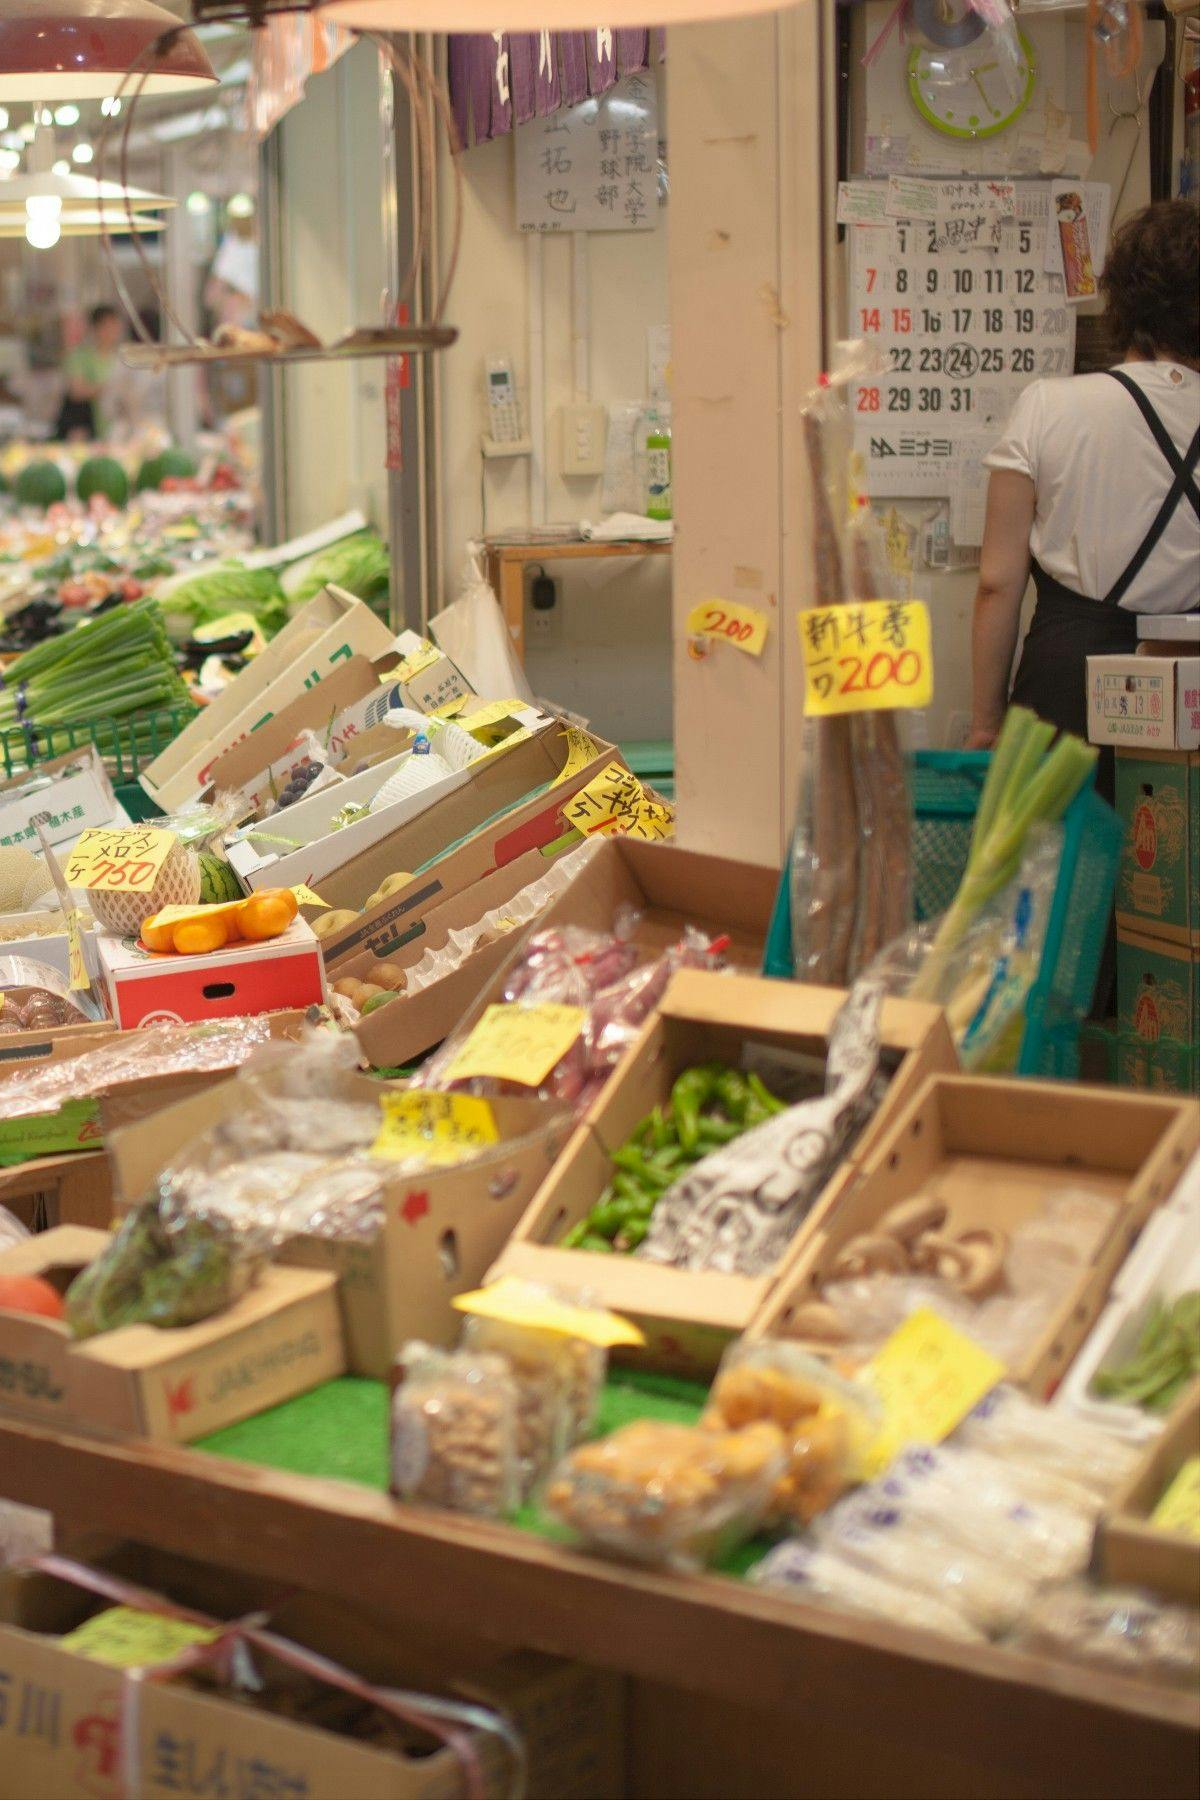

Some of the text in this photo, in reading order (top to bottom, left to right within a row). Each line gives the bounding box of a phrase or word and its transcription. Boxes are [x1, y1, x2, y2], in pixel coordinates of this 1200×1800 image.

[1019, 229, 1032, 253] 5
[866, 268, 878, 294] 7
[896, 269, 908, 293] 8
[926, 269, 938, 293] 9
[954, 269, 973, 293] 10
[985, 269, 1003, 293] 11
[1016, 269, 1035, 293] 12
[861, 309, 1068, 335] 14 15 16 17 18 19 20
[890, 349, 911, 372] 22
[920, 349, 942, 372] 23
[951, 349, 972, 373] 24
[981, 349, 1003, 372] 25
[1012, 349, 1034, 372] 26
[1043, 349, 1067, 373] 27
[857, 388, 971, 412] 28 29 30 31
[704, 610, 754, 641] 200
[838, 650, 921, 695] 200
[79, 830, 153, 848] アンデス
[93, 842, 159, 862] メロン
[87, 859, 157, 888] 750
